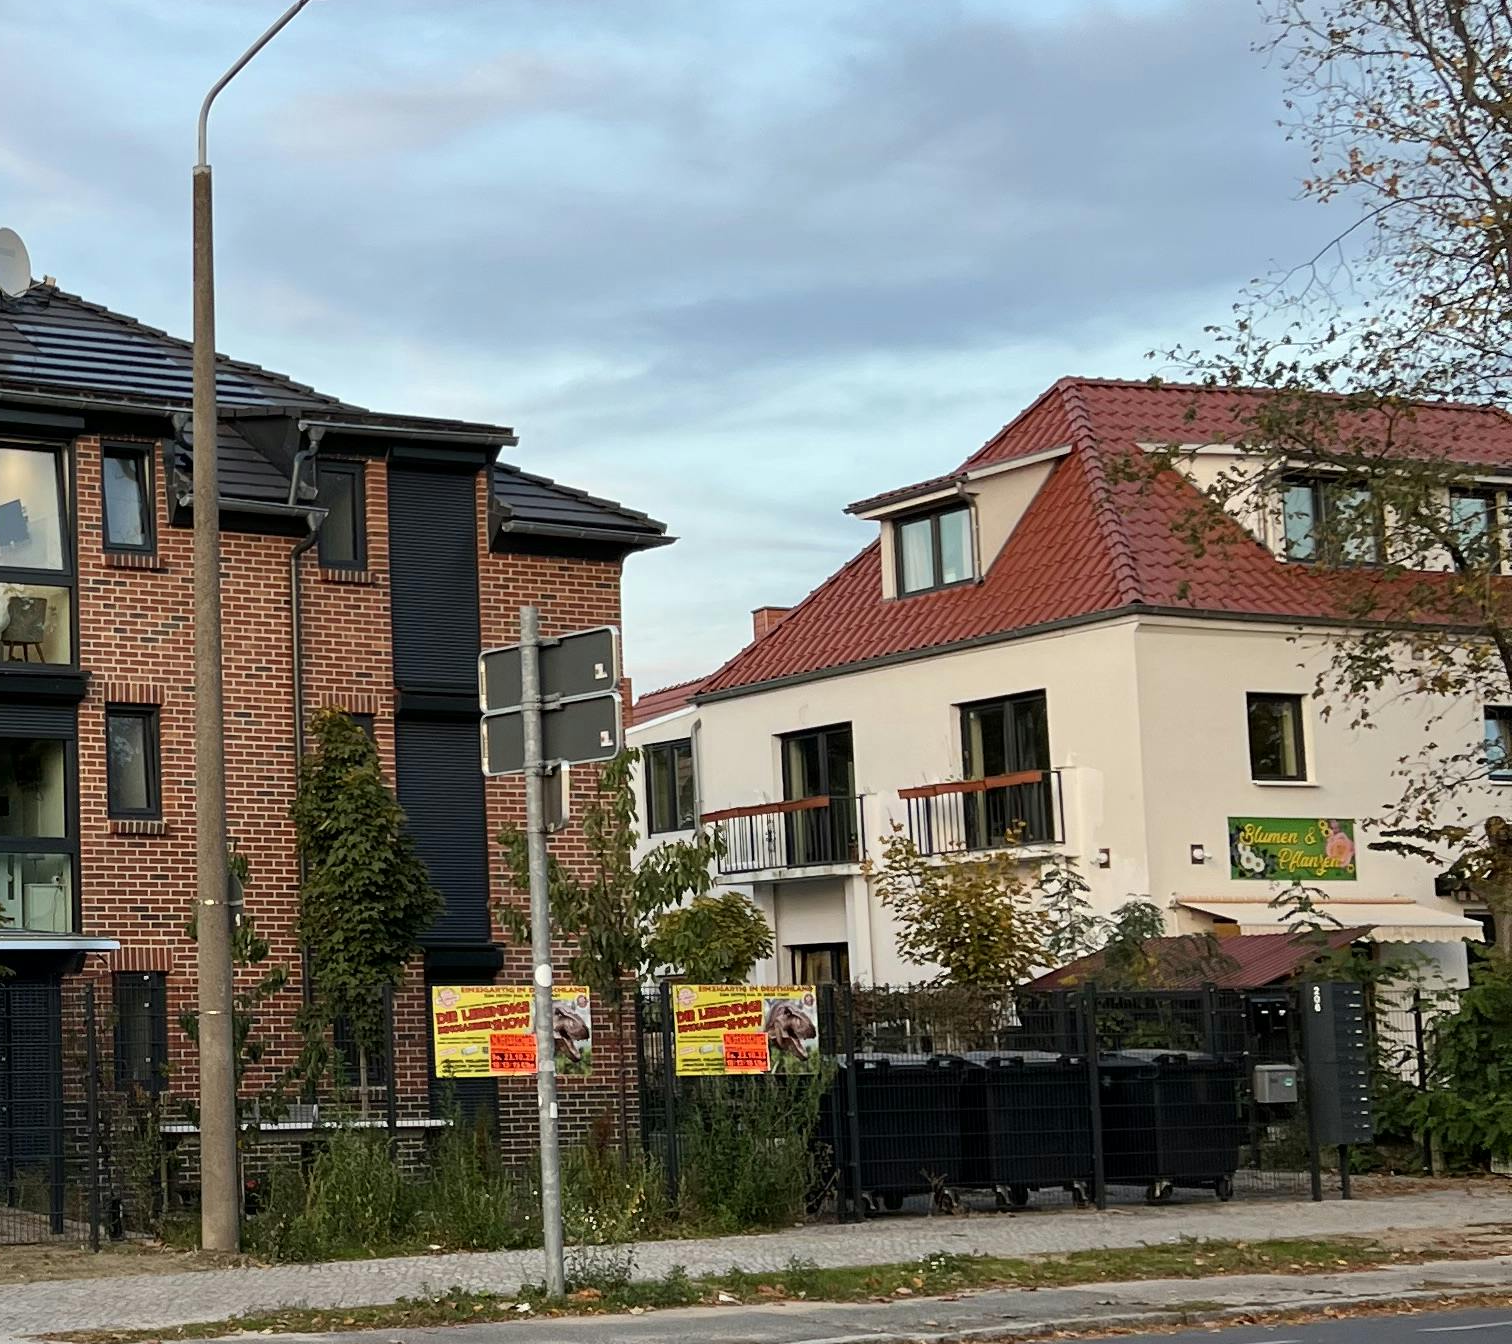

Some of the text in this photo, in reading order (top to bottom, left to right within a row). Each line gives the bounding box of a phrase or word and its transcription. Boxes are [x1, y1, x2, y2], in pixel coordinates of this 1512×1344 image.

[1240, 824, 1316, 845] Blumen &
[1278, 848, 1340, 876] Pflanzen
[436, 1010, 458, 1025] DIE
[676, 1009, 695, 1024] DIE
